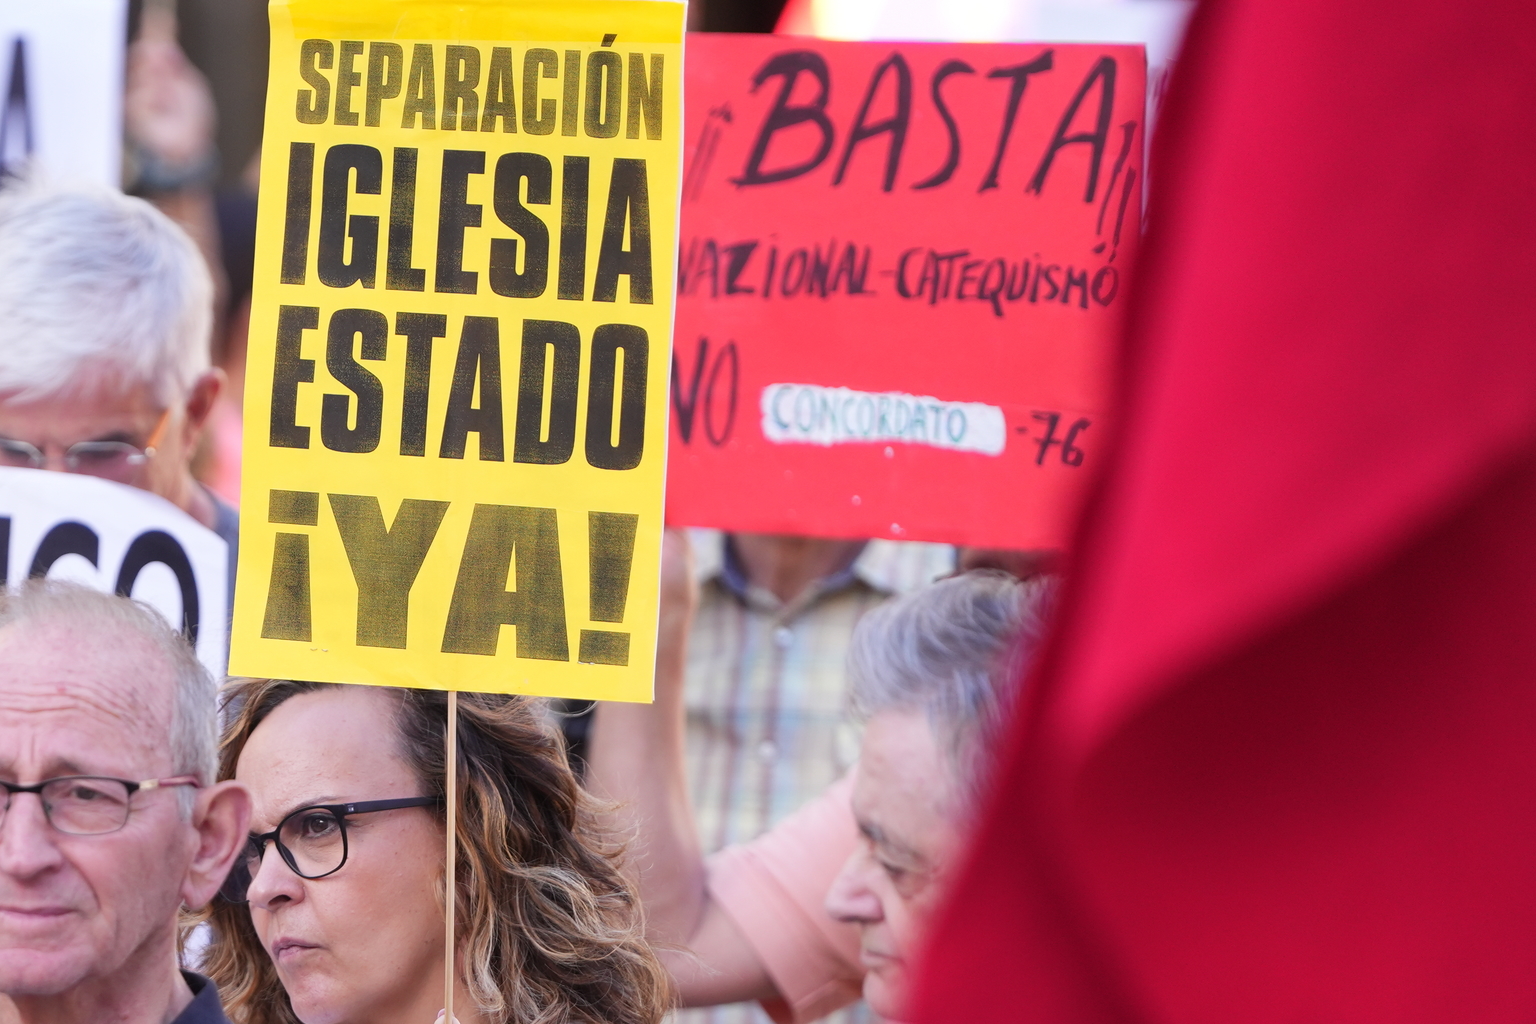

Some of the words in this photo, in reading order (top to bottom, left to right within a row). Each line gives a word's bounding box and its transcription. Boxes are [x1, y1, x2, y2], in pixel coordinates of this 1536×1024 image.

[295, 34, 665, 141] SEPARACIÓN
[279, 141, 655, 305] IGLESIA
[268, 304, 651, 472] ESTADO
[768, 384, 970, 444] CONCORDATO
[260, 488, 641, 667] ¡YA!
